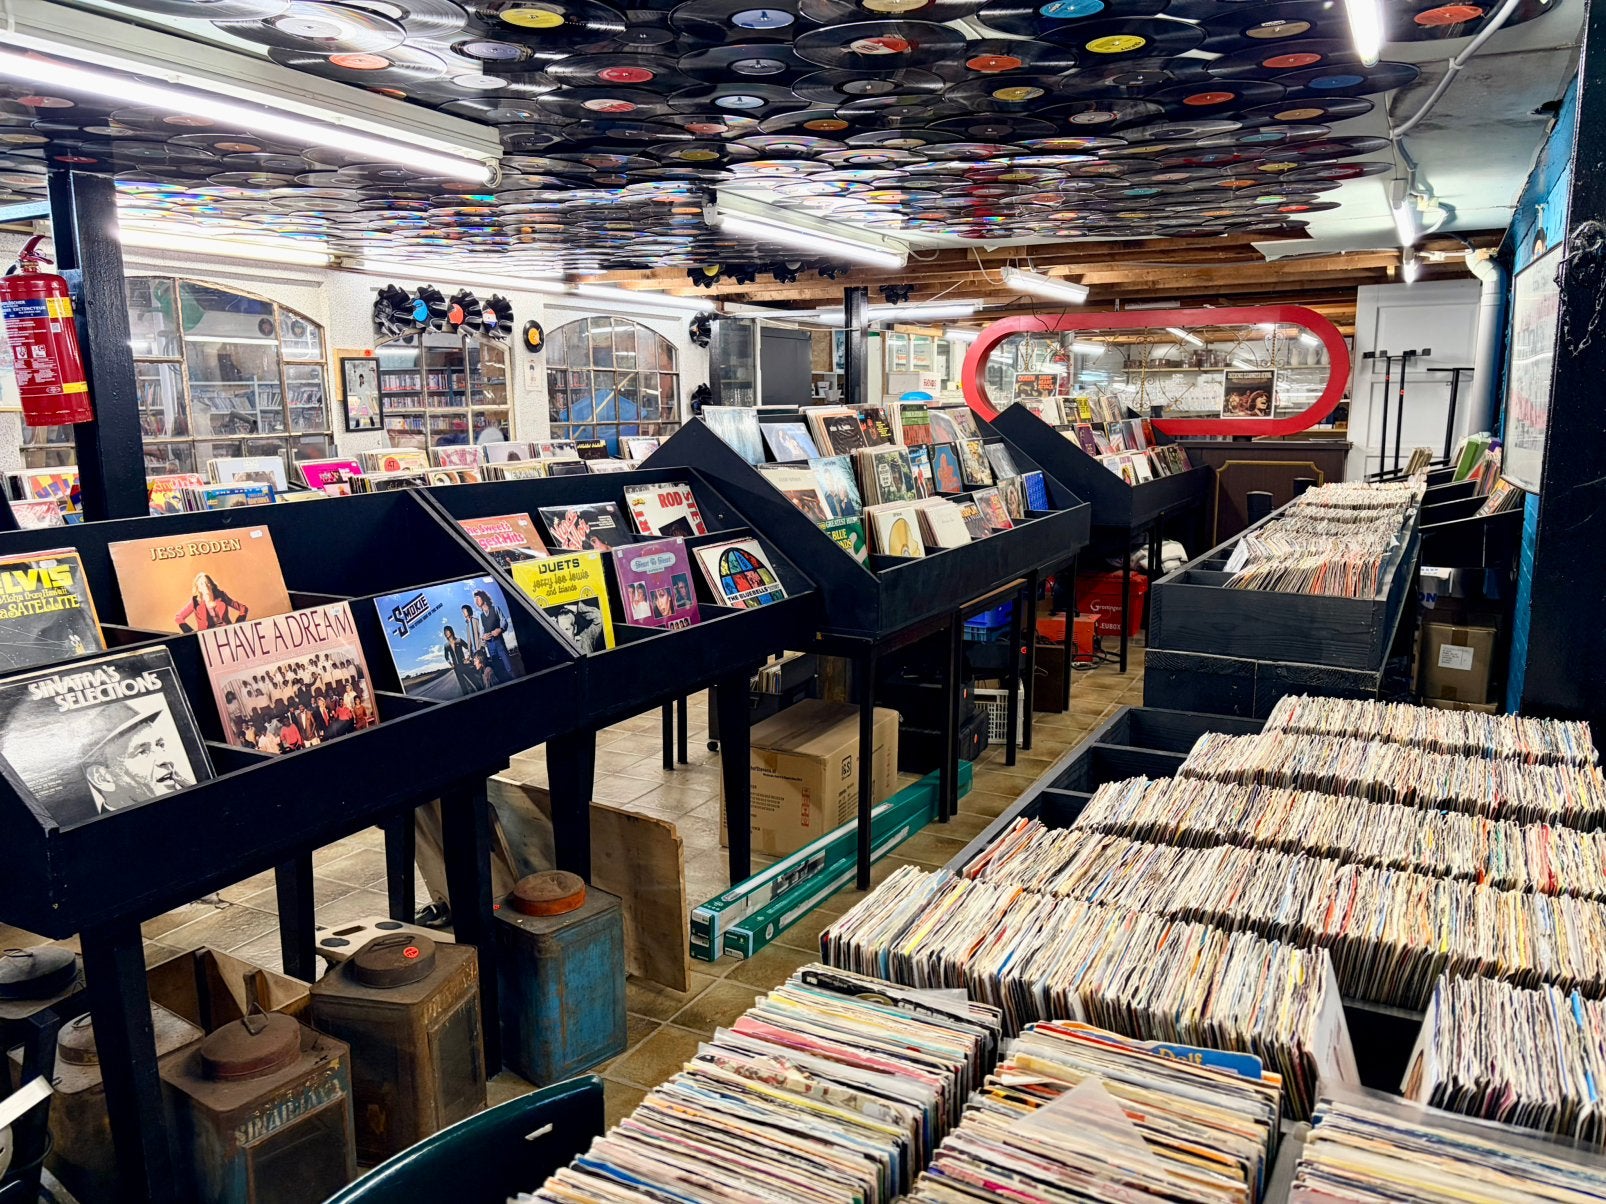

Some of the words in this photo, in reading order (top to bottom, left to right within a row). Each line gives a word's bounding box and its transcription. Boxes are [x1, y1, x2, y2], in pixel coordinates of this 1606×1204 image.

[657, 491, 683, 509] ROD
[501, 532, 525, 545] Hits
[832, 528, 848, 541] BLUE
[150, 543, 184, 562] JESS
[190, 538, 242, 557] RODEN
[538, 558, 580, 575] DUETS
[0, 564, 74, 595] LVIS
[739, 586, 769, 600] BLUEBELLS
[8, 594, 81, 619] SATELLITE
[388, 593, 430, 638] SMOKIE
[204, 634, 214, 669] I
[215, 621, 270, 665] HAVE
[272, 626, 285, 652] A
[286, 607, 354, 649] DREAM
[28, 665, 121, 701] SINATRA'S
[54, 672, 163, 712] SELECTIONS
